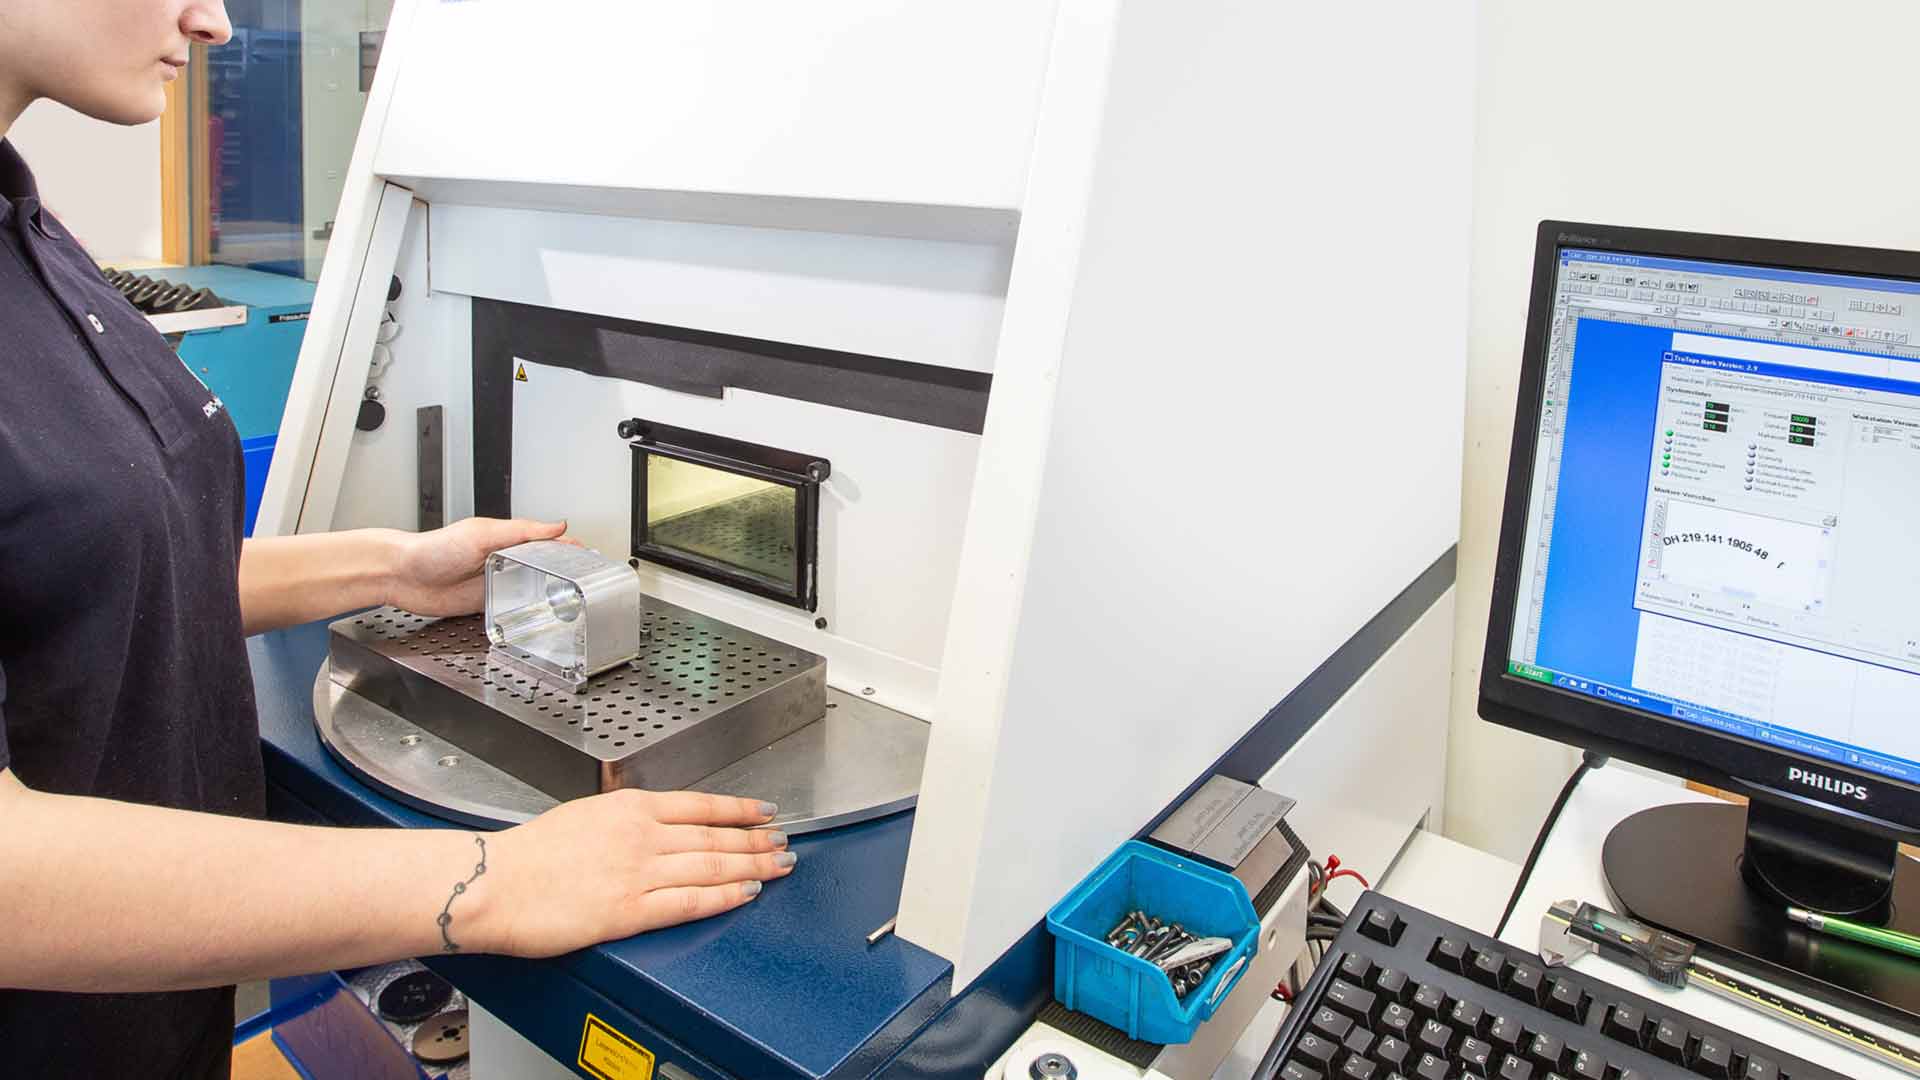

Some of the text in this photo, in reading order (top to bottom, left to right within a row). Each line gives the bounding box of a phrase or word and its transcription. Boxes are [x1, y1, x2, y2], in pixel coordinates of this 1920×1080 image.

[1663, 533, 1769, 561] DH 219.141 1905 48
[1524, 666, 1545, 679] Start
[1788, 767, 1869, 801] PHILIPS
[1390, 1004, 1401, 1014] Q
[1428, 1020, 1442, 1033] W
[1385, 1039, 1395, 1049] A
[1465, 1038, 1476, 1050] E
[1423, 1055, 1434, 1066] S
[1506, 1056, 1519, 1068] R
